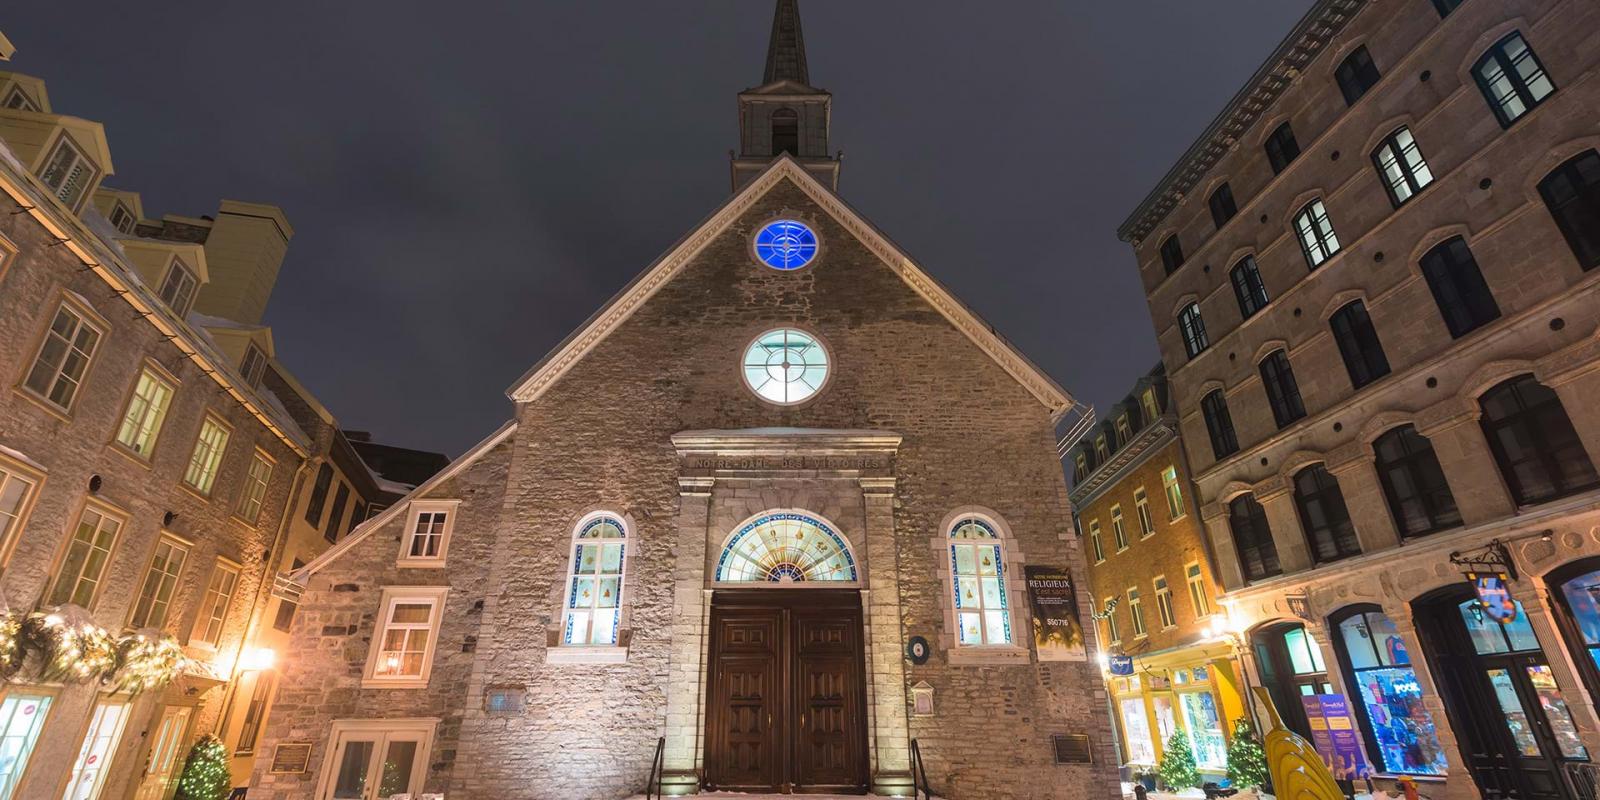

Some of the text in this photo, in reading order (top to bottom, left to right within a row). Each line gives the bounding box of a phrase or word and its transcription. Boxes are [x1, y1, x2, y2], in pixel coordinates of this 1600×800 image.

[695, 460, 769, 469] NOTRE-DAME
[782, 460, 802, 469] DES
[1029, 580, 1070, 588] RELIGIEUX
